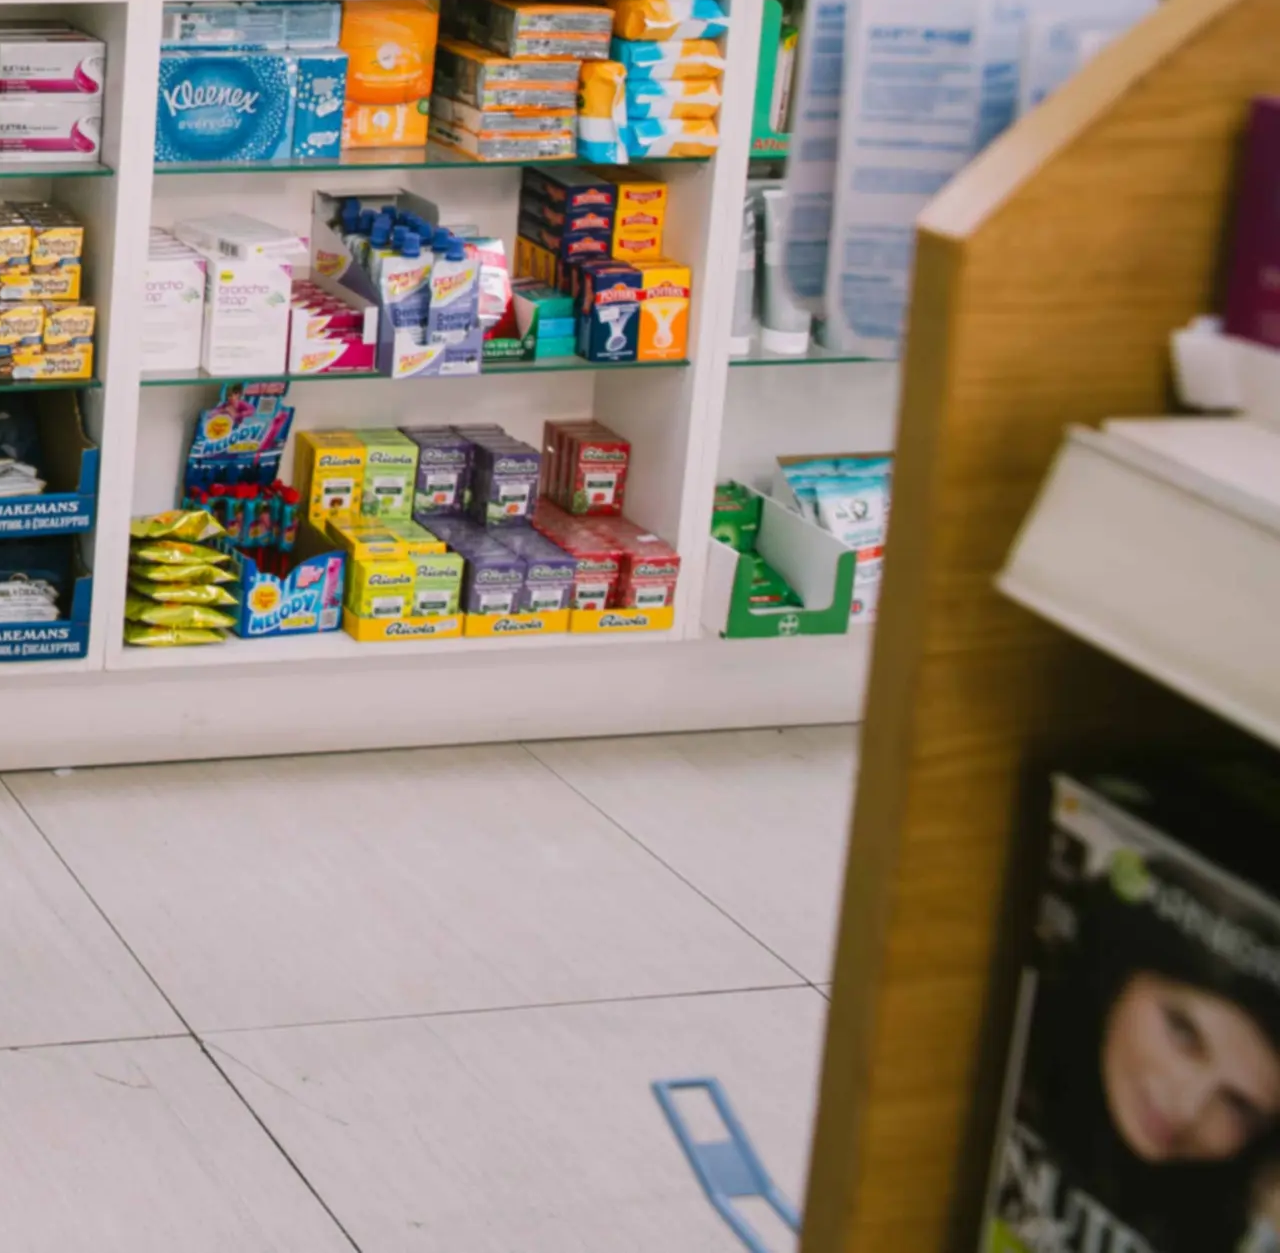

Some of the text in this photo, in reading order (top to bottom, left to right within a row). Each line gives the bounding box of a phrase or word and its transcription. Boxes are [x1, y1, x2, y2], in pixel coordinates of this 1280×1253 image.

[163, 81, 260, 117] Kleenex
[178, 116, 243, 131] everyday
[218, 284, 270, 295] broncho
[218, 296, 248, 307] stop
[319, 455, 361, 467] Ricola
[369, 452, 413, 465] Ricola
[32, 515, 90, 531] EUCALYPTUS
[368, 574, 412, 587] Ricola
[249, 592, 318, 635] MELODY
[385, 622, 435, 636] Ricola
[493, 617, 543, 633] Ricola
[598, 614, 649, 629] Ricola
[22, 641, 81, 657] EUCALYPTUS
